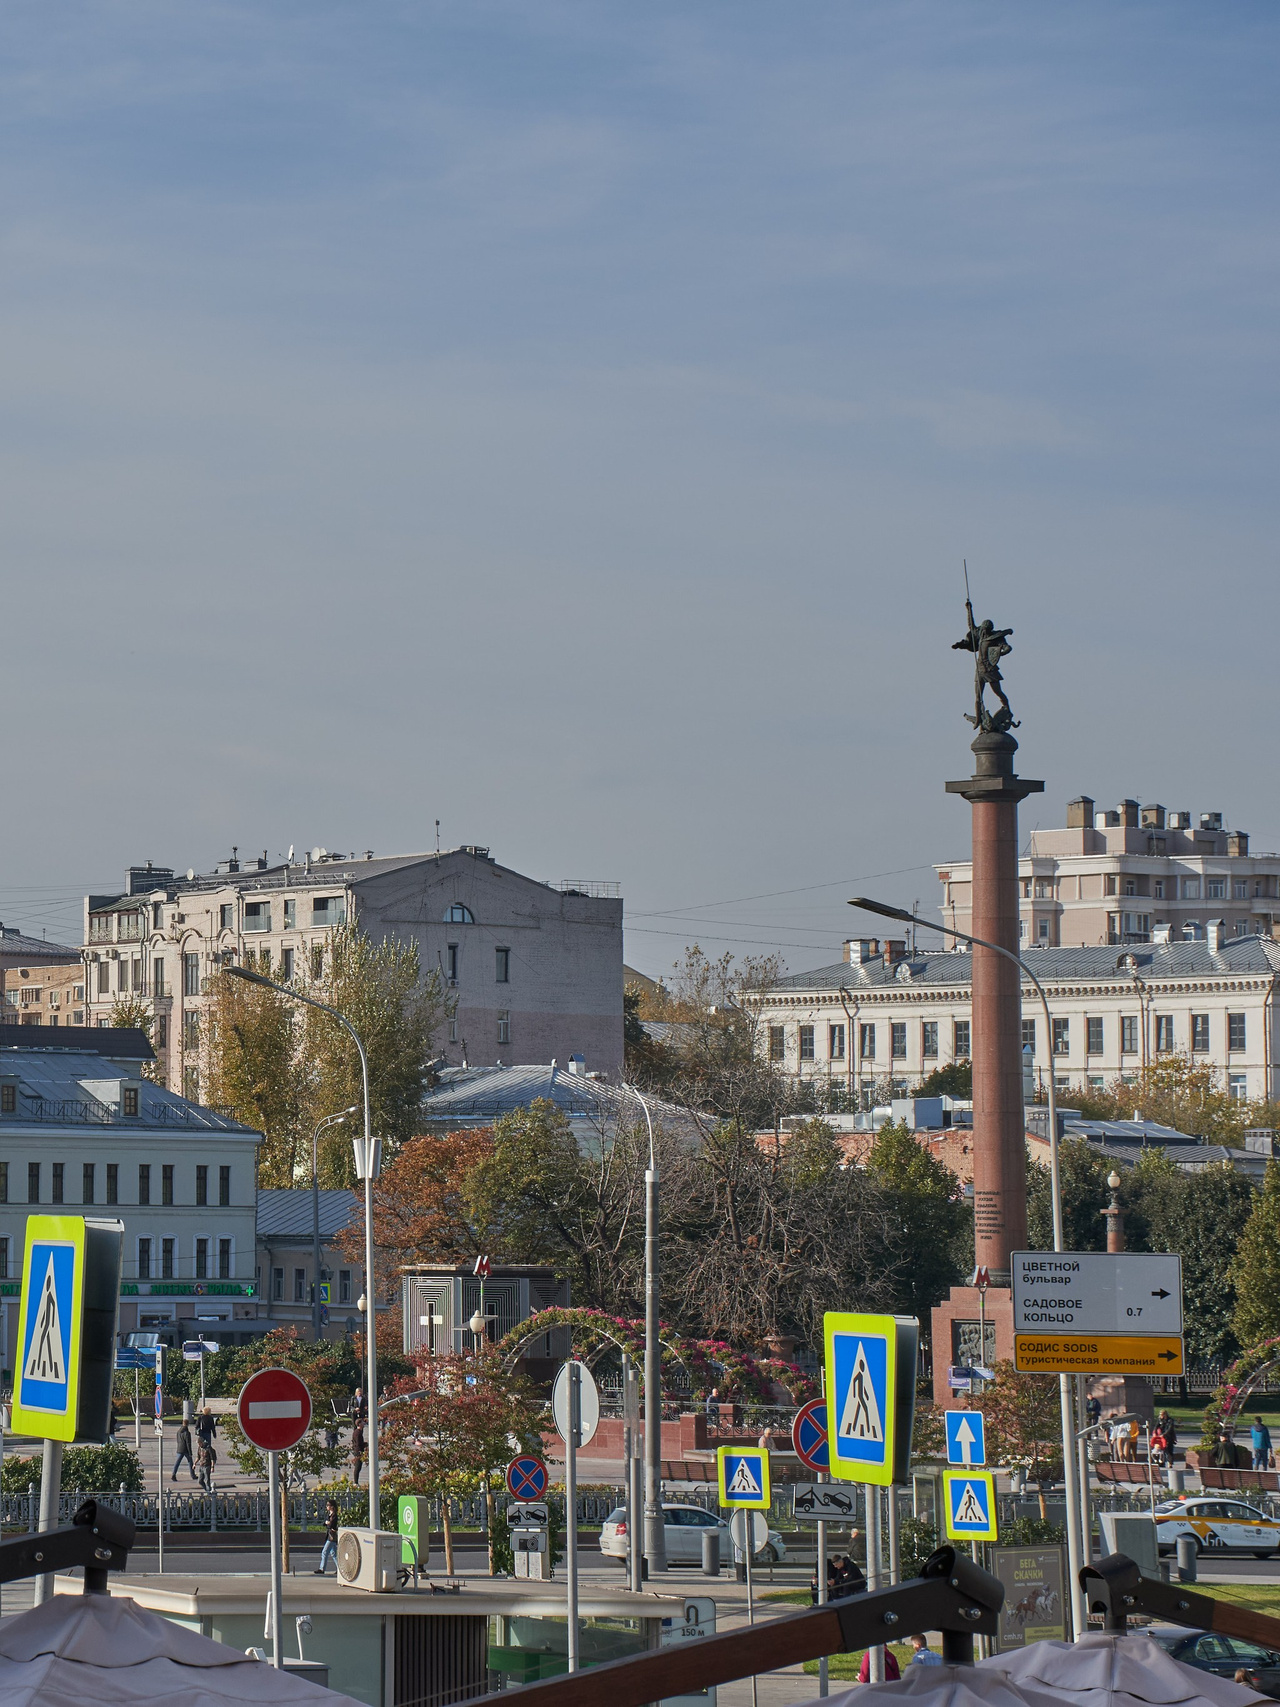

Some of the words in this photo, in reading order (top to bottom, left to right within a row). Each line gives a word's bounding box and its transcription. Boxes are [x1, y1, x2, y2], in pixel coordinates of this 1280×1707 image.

[1022, 1260, 1080, 1272] ЦВЕТНОЙ
[1022, 1274, 1071, 1285] бульвар
[1023, 1299, 1082, 1309] САДОВОЕ
[1126, 1307, 1143, 1317] 0.7
[1023, 1313, 1074, 1323] КОЛЬЦО
[1019, 1342, 1060, 1353] СОДИС
[1063, 1343, 1098, 1353] SODIS
[1019, 1356, 1099, 1365] туристическая
[1102, 1357, 1156, 1366] компания
[1019, 1558, 1037, 1569] БЕГА
[1013, 1570, 1044, 1580] СКАЧКИ
[681, 1628, 696, 1637] 150
